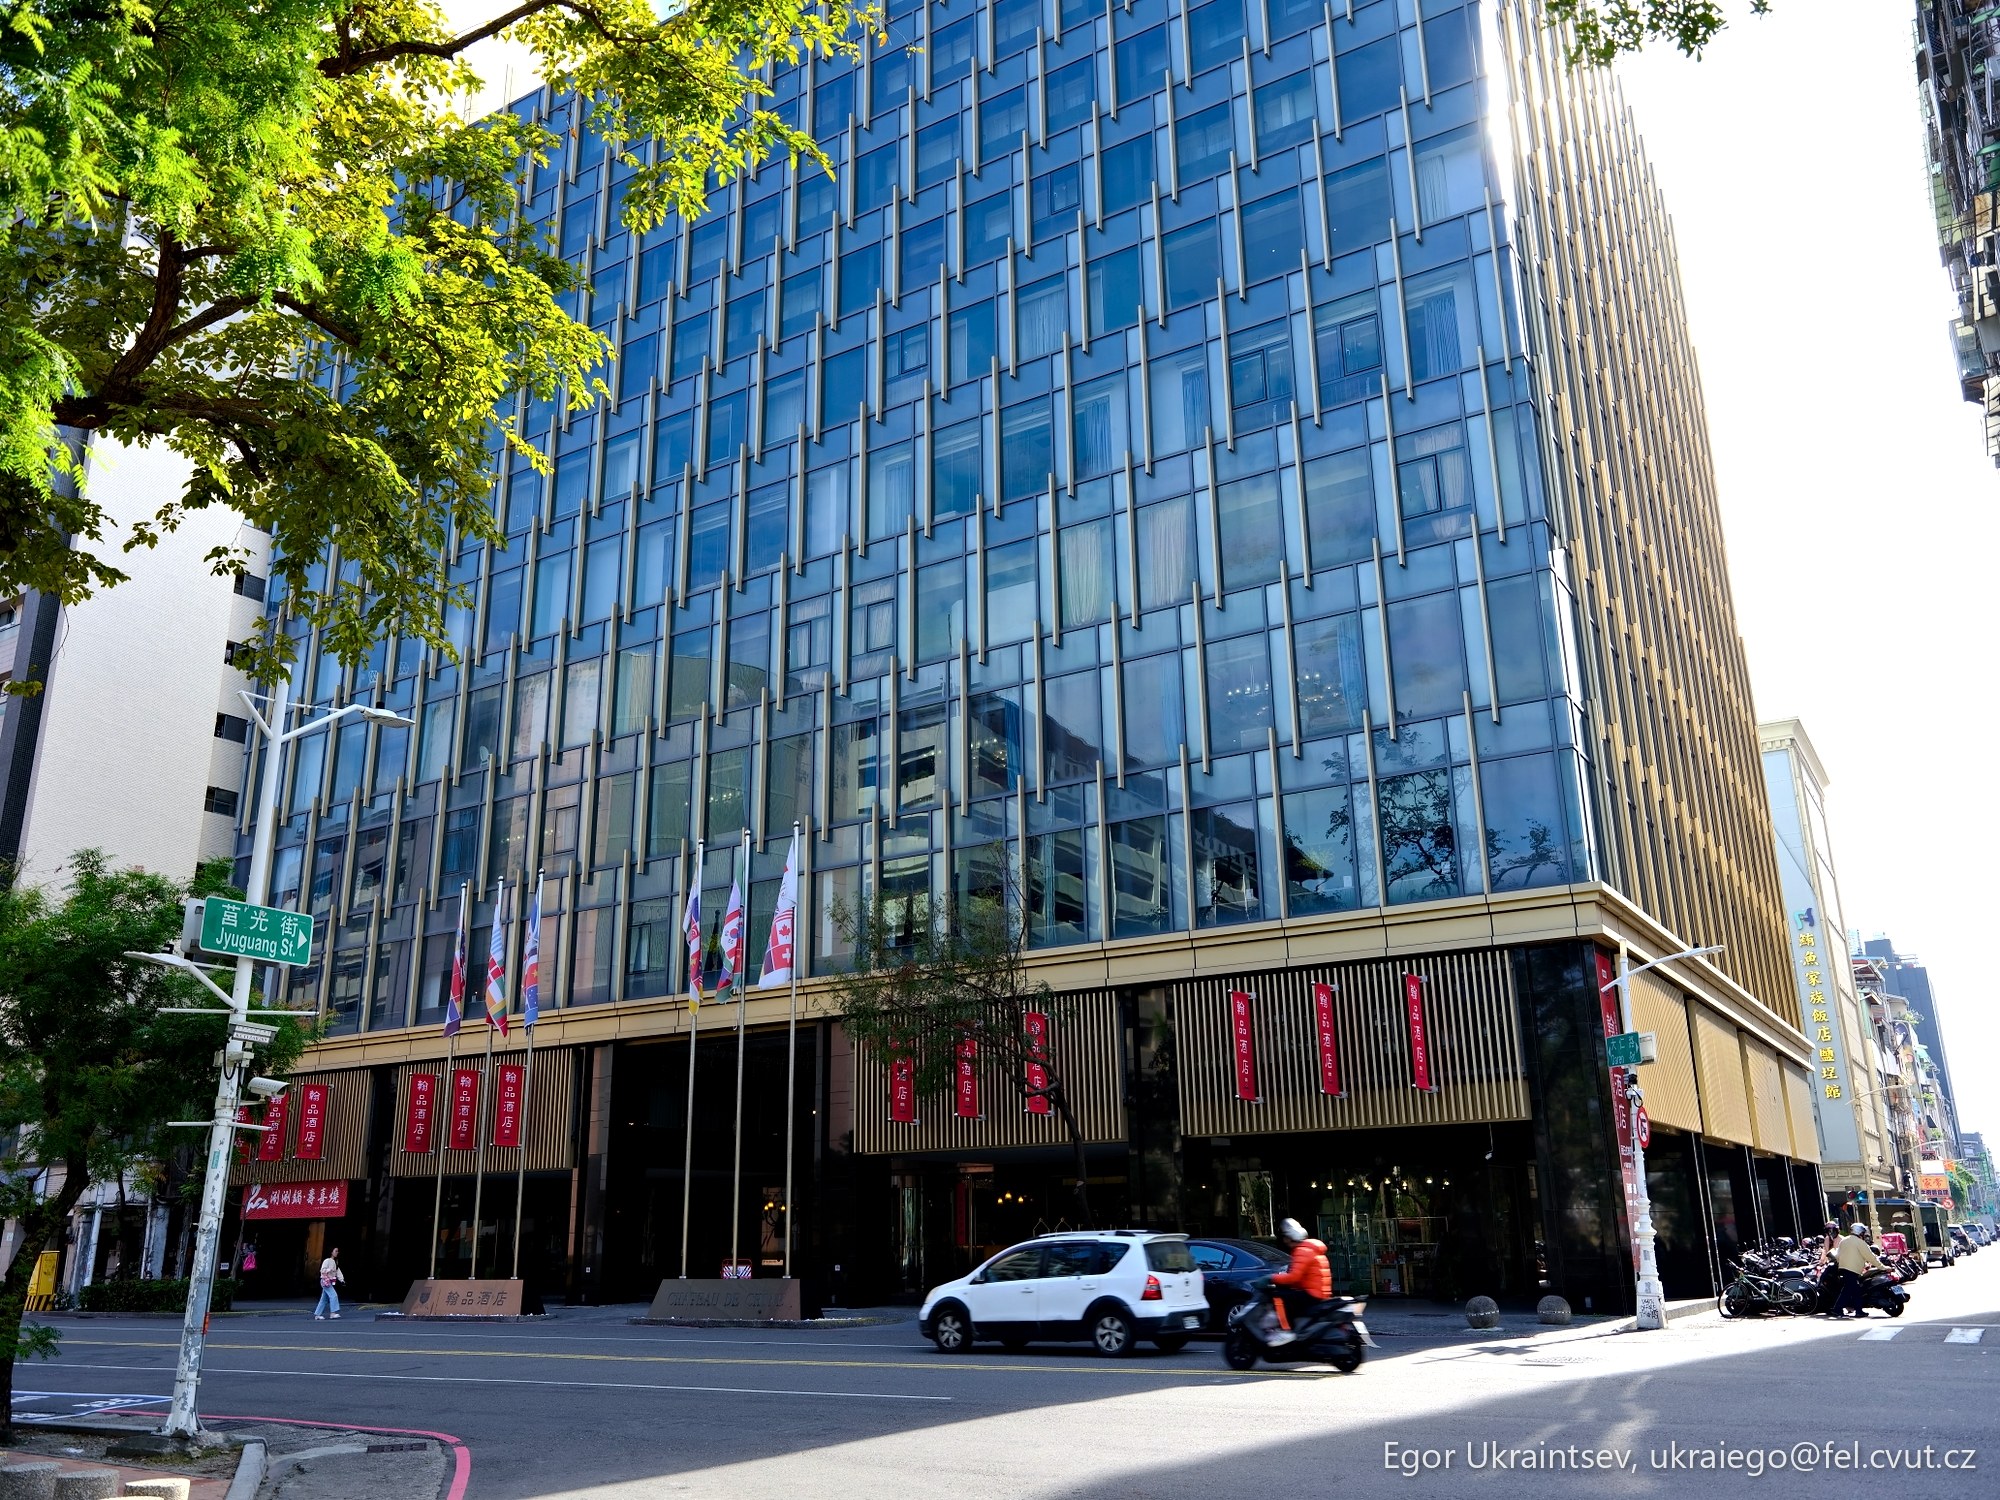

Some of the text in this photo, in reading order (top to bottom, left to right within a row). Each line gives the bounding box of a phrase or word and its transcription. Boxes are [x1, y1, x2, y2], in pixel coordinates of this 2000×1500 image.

[216, 927, 296, 958] Jyuguang St.
[222, 903, 298, 938] 莒光街
[1236, 1000, 1249, 1075] 翰品酒店
[1319, 992, 1332, 1069] 翰品酒店
[304, 1090, 320, 1142] 翰品酒店
[413, 1080, 429, 1135] 翰品酒店
[457, 1075, 472, 1132] 翰品酒店
[502, 1071, 517, 1128] 翰品酒店
[445, 1291, 507, 1306] 翰品酒店
